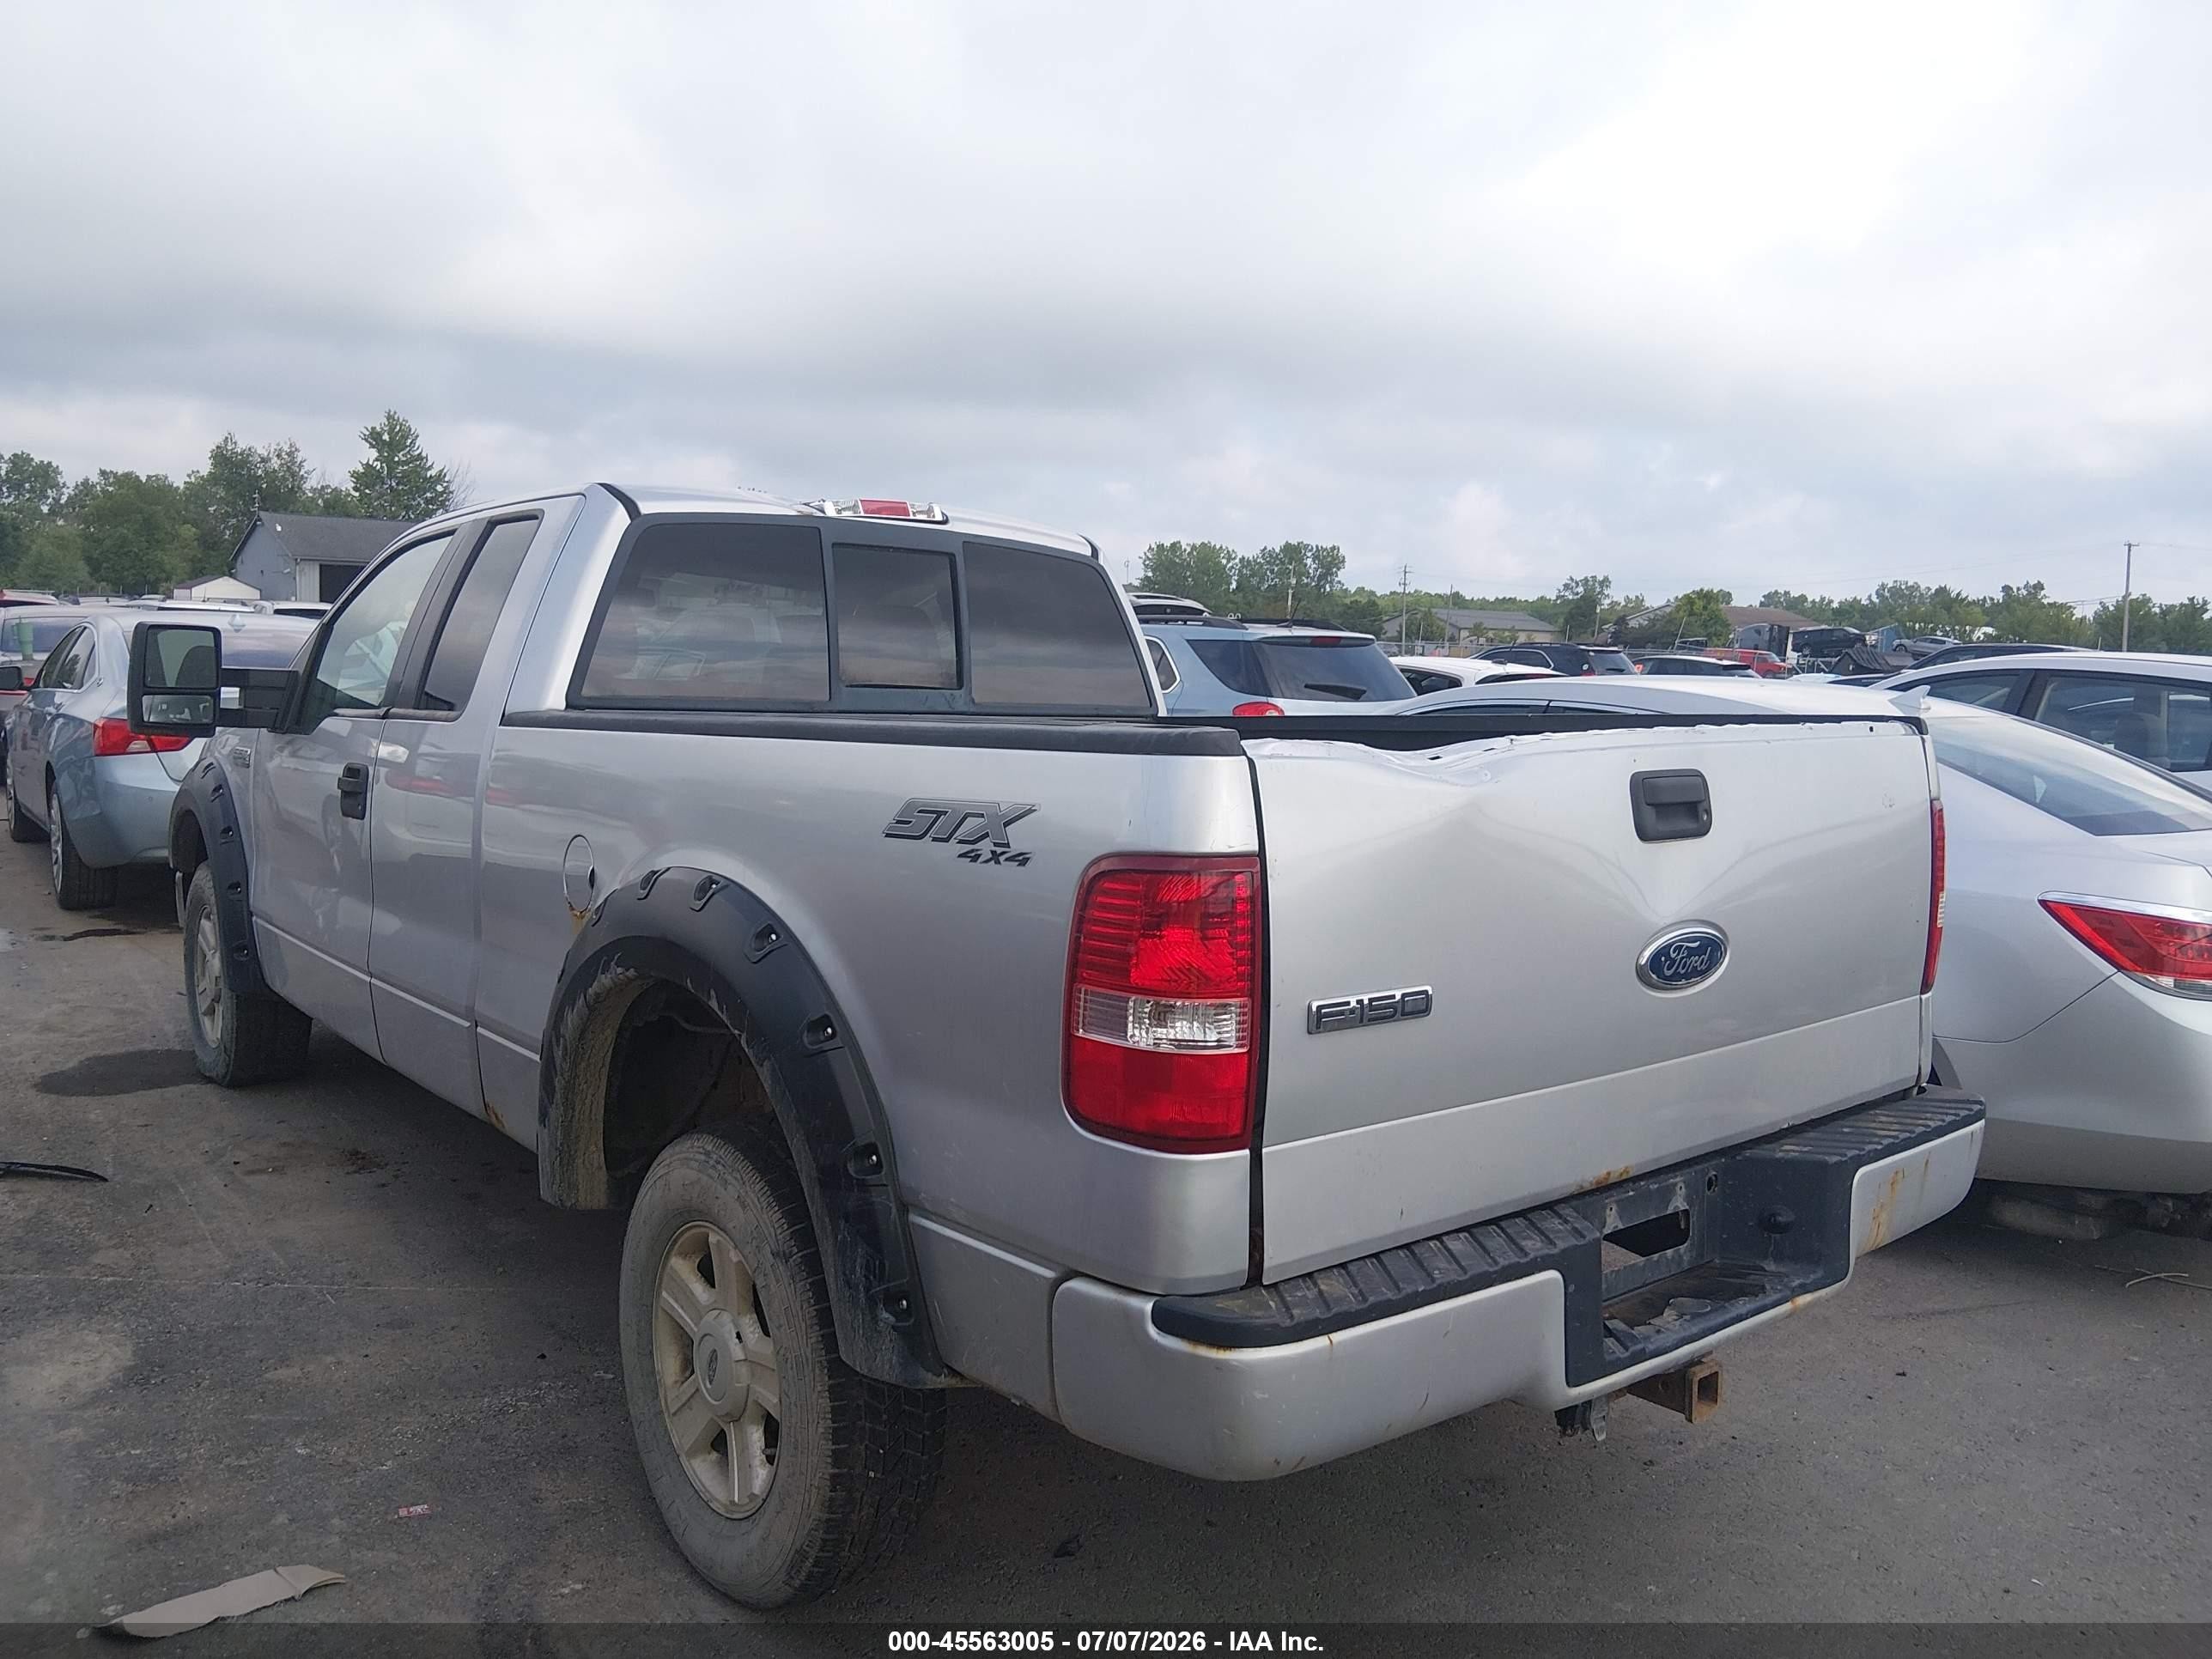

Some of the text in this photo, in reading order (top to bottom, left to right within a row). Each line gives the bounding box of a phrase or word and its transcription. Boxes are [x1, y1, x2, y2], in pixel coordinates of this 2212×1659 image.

[883, 798, 1037, 848] STX
[1662, 941, 1711, 976] Ford
[1315, 988, 1431, 1031] F-150
